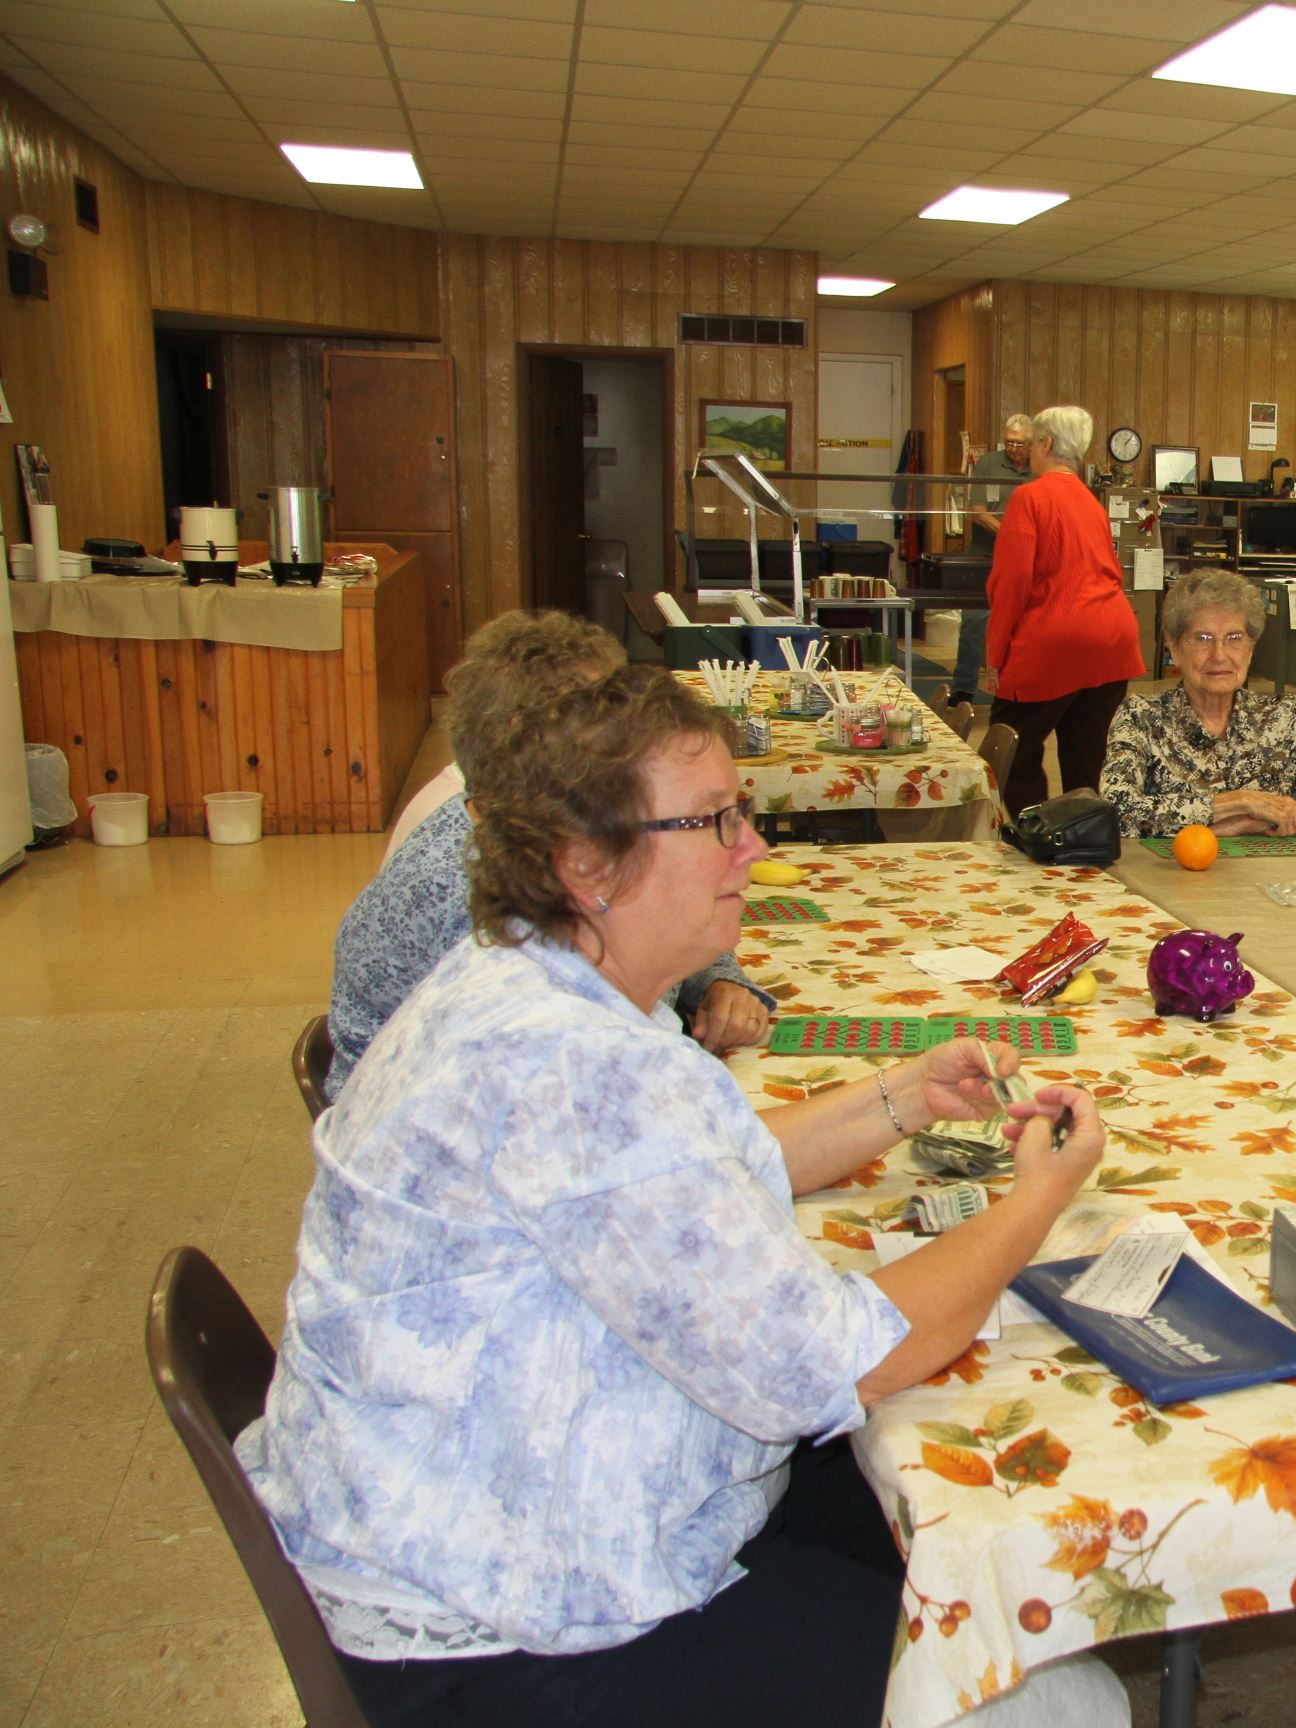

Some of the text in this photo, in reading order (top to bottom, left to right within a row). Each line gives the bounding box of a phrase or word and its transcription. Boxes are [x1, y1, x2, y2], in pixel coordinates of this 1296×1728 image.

[1052, 1022, 1072, 1050] BINGO
[1143, 1317, 1190, 1346] County
[1178, 1343, 1222, 1364] Bank
